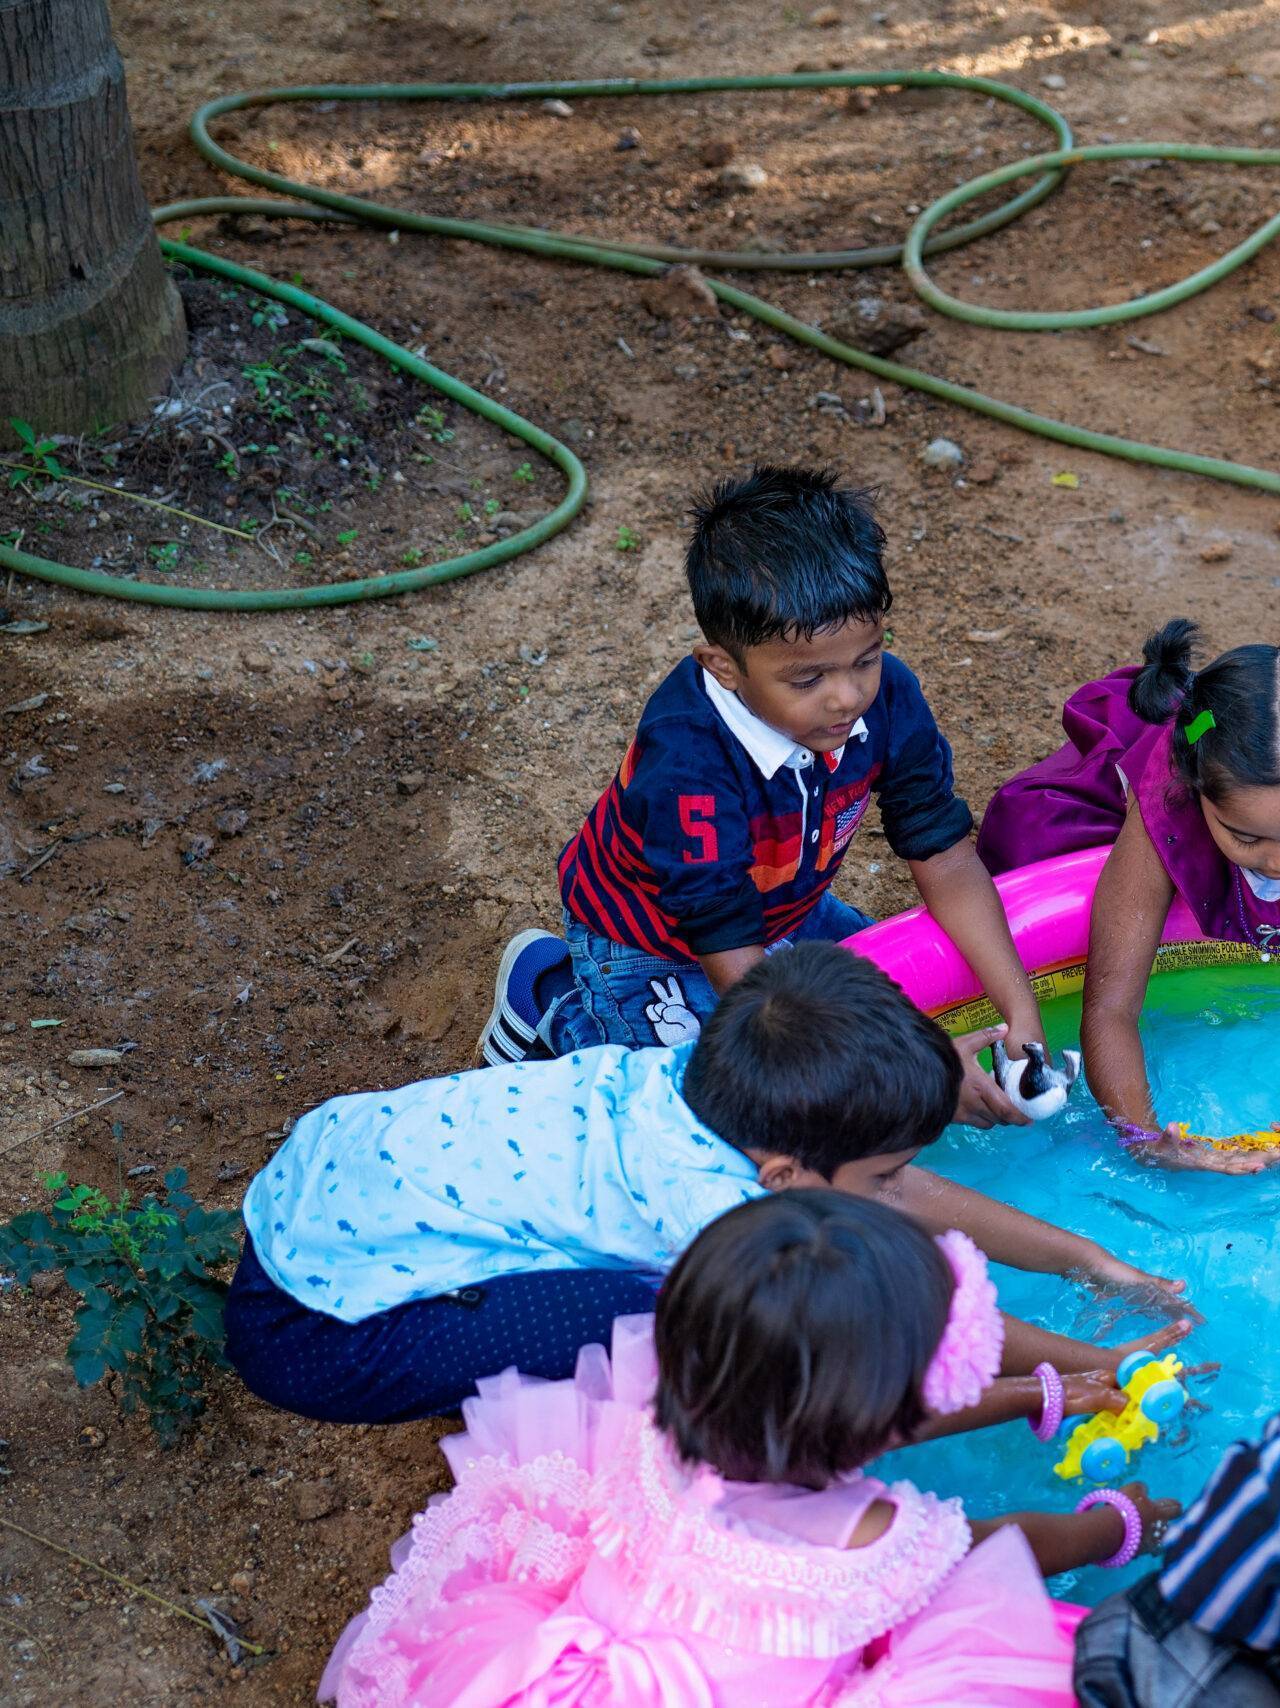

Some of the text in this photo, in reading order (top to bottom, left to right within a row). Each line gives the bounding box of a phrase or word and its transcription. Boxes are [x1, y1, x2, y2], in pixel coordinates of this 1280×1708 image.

[678, 795, 719, 863] 5
[1188, 943, 1220, 955] SWIMMING
[1157, 956, 1175, 965] ADULT
